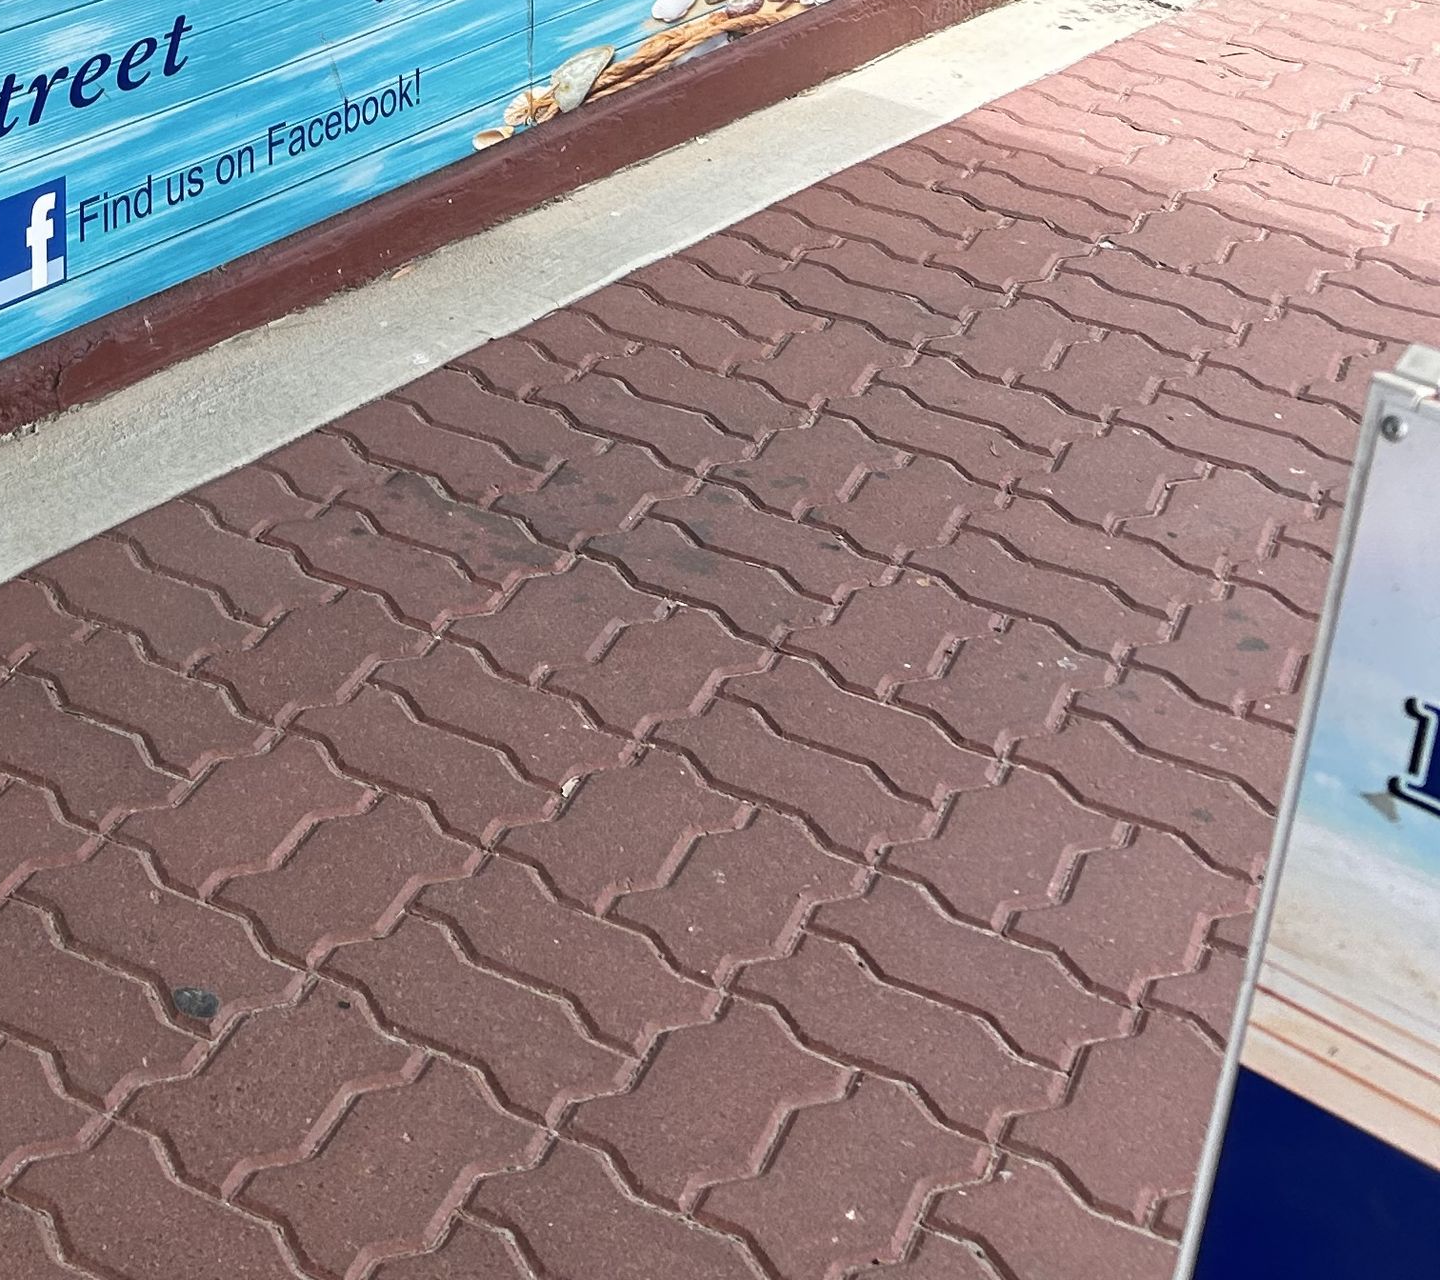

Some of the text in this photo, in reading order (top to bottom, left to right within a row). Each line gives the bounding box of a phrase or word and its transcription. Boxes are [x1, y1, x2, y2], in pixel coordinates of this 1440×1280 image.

[77, 178, 156, 244] Find
[165, 165, 205, 217] us
[216, 142, 256, 190] on
[266, 69, 425, 167] Facebook!
